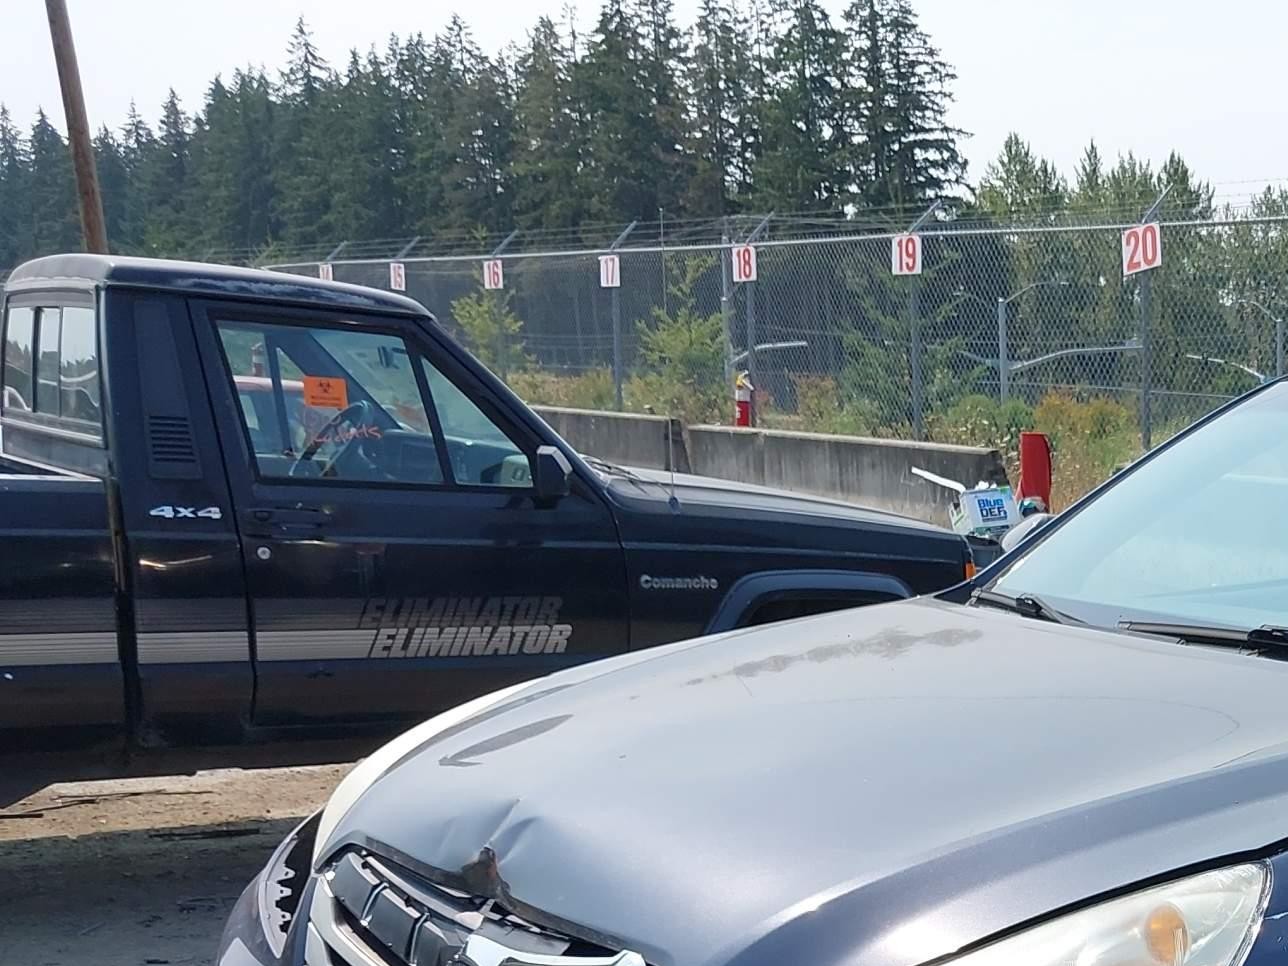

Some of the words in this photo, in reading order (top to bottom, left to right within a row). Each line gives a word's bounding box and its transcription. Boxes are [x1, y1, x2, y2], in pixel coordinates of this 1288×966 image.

[736, 247, 751, 279] 18
[897, 237, 916, 272] 19
[1126, 226, 1157, 272] 20
[392, 265, 403, 288] 15
[488, 262, 500, 287] 16
[605, 257, 615, 285] 17
[977, 498, 1004, 508] Blue
[640, 574, 719, 589] Comanche
[360, 597, 563, 628] ELIMINATOR
[370, 624, 573, 657] ELIMINATOR
